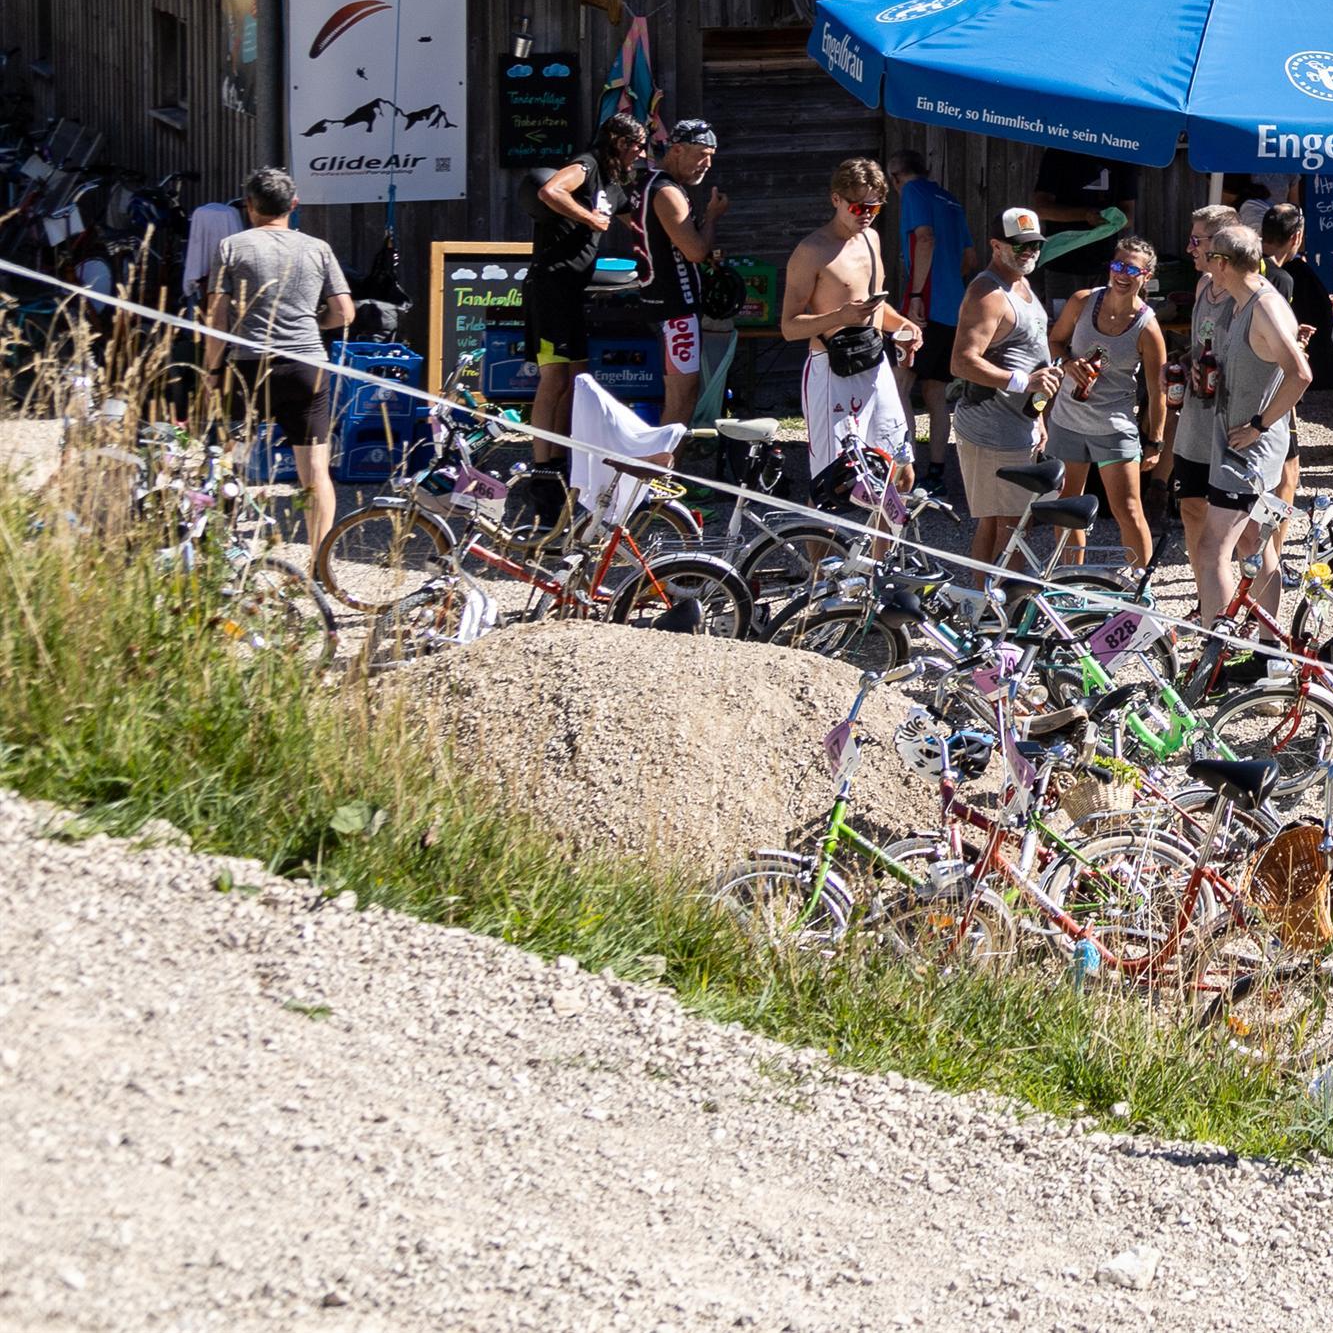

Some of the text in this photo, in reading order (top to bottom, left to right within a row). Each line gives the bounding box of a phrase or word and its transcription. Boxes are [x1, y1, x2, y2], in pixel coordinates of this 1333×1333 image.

[821, 21, 863, 83] Engelbräu
[916, 96, 1140, 151] Ein Bier, so himmlisch wie sein Name
[309, 154, 427, 172] GlideAir
[671, 243, 695, 305] GHOS
[457, 335, 478, 347] wie
[594, 369, 653, 384] Engelbräu
[1105, 619, 1138, 649] 828
